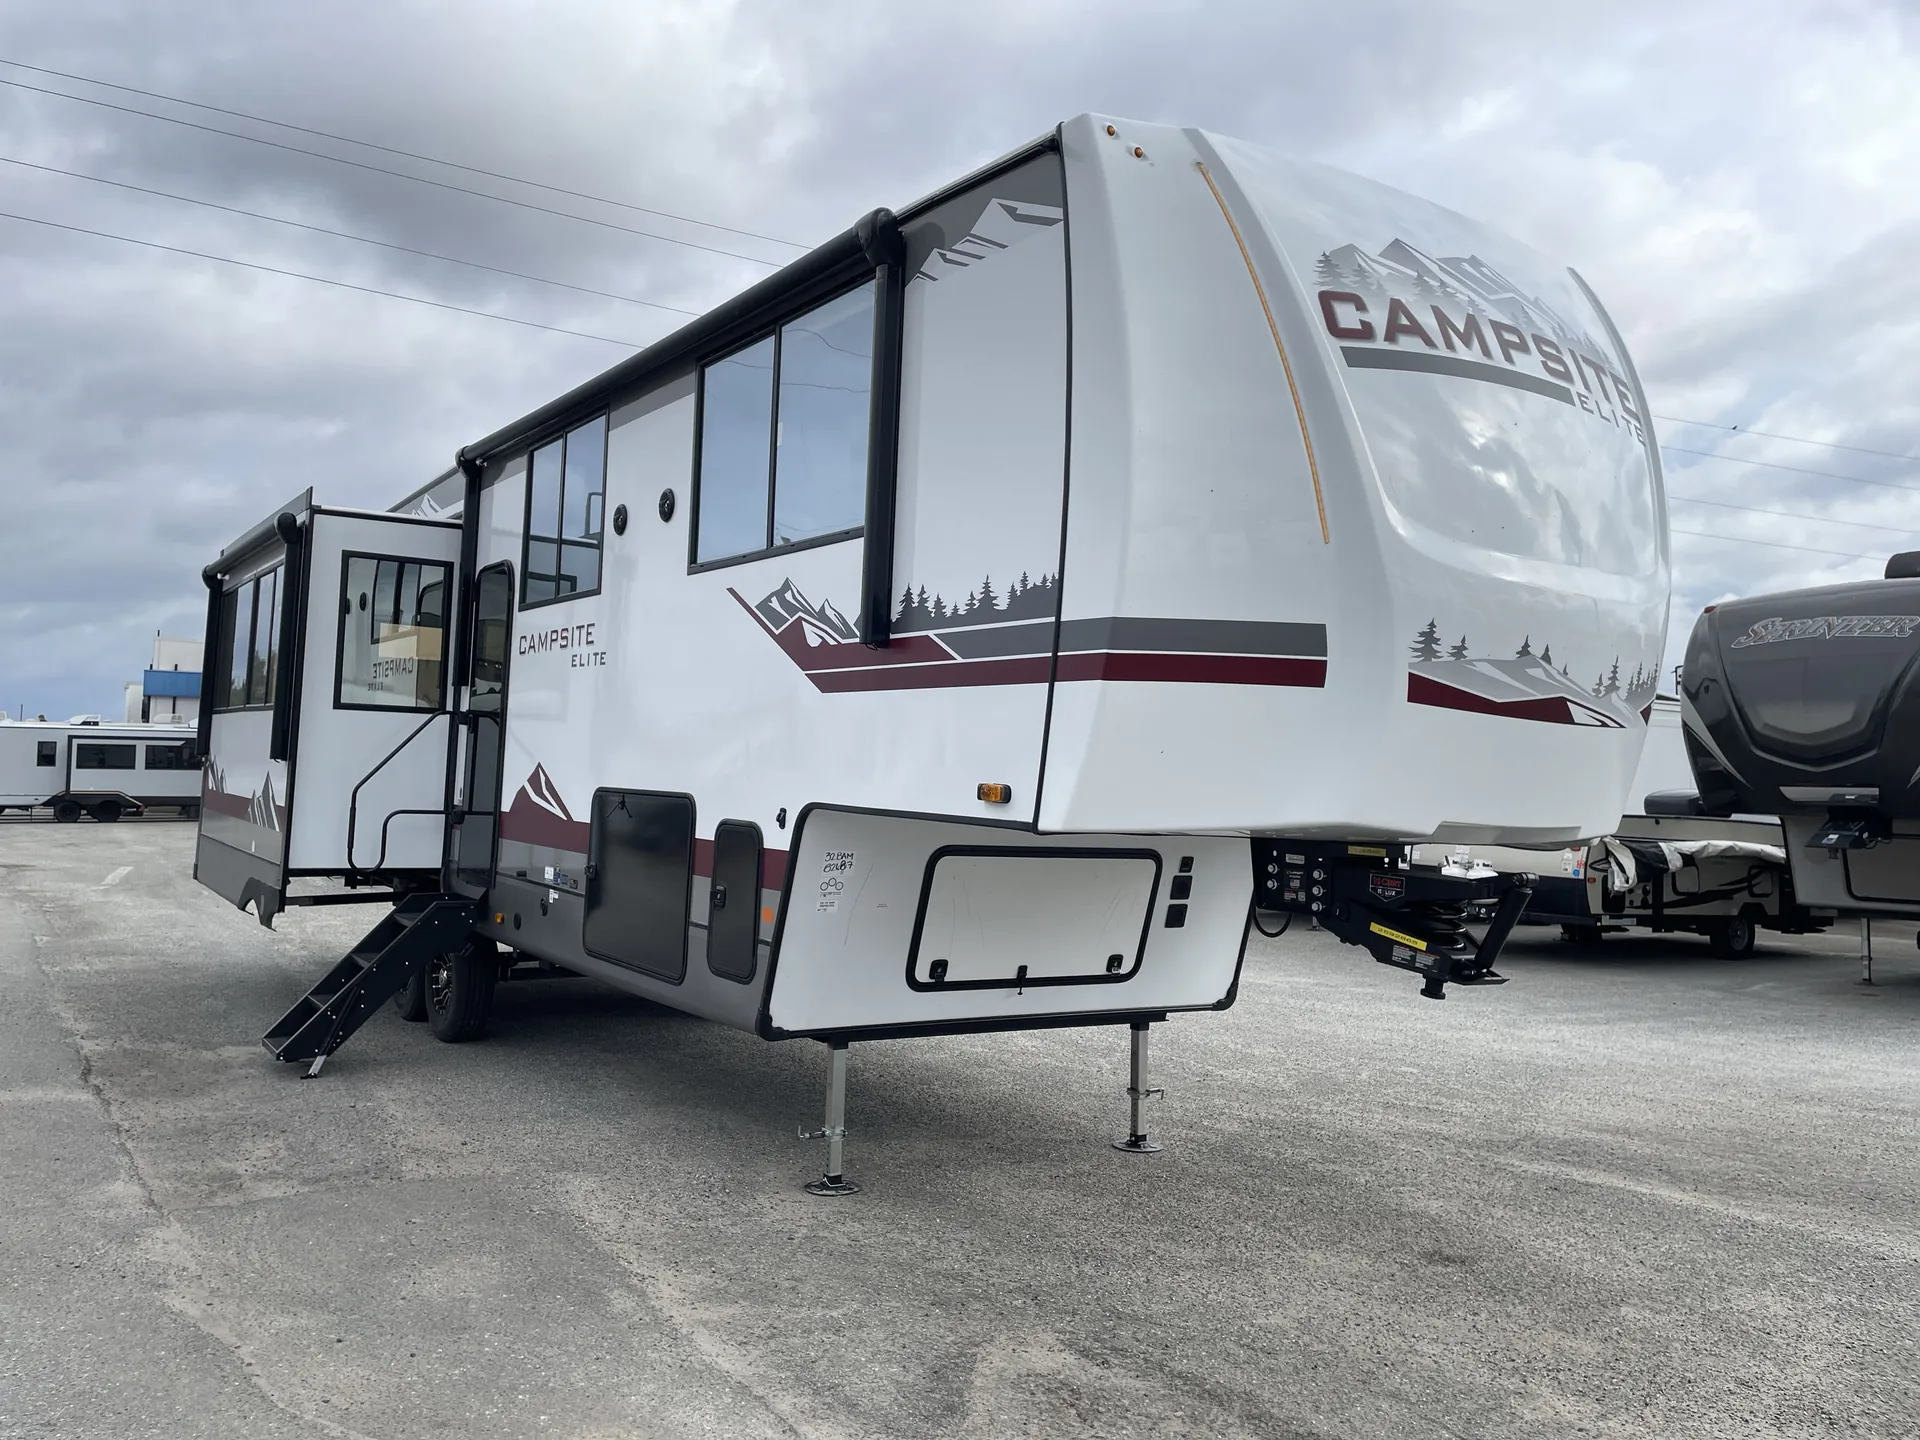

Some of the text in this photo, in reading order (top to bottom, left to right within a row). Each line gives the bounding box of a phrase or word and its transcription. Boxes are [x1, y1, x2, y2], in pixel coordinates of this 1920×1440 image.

[1318, 289, 1641, 424] CAMPSITE
[1580, 391, 1647, 447] ELITE
[519, 623, 595, 655] CAMPSITE
[571, 652, 607, 667] ELITE
